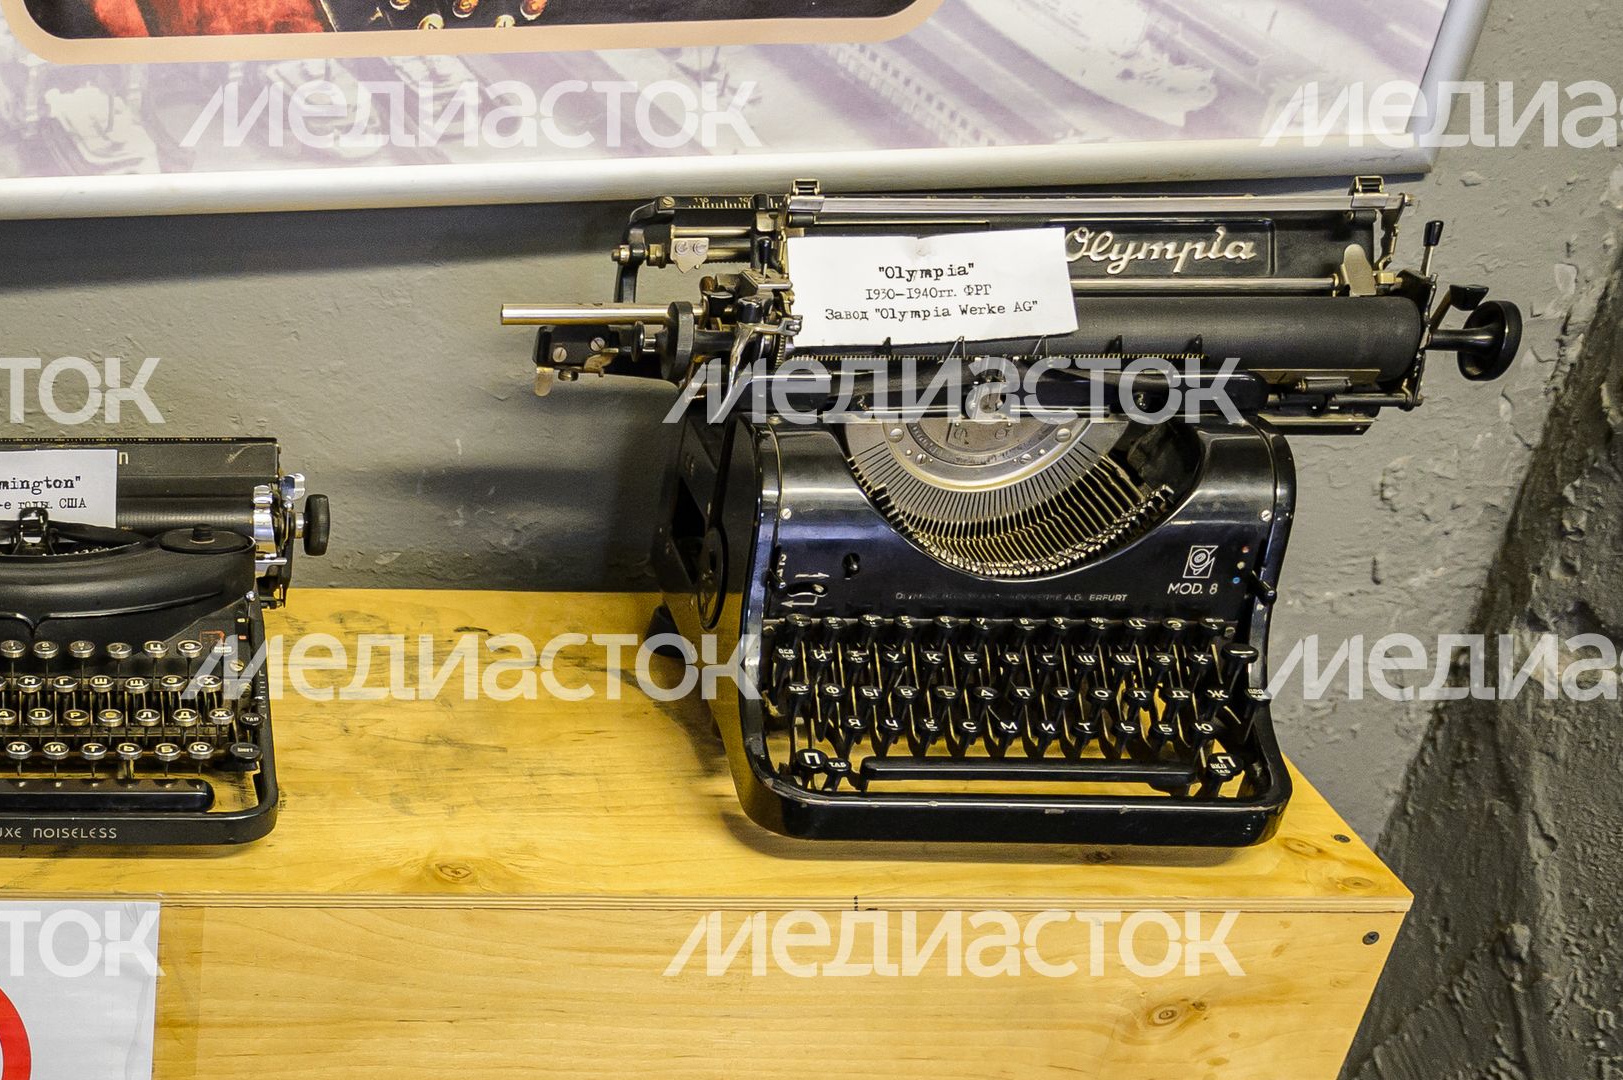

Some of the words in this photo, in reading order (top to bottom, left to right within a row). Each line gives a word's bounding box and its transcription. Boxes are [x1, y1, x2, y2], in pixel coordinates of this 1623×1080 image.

[1065, 226, 1258, 274] Olympia
[878, 261, 975, 283] "Olympia"
[963, 283, 993, 299] ФРГ
[825, 305, 869, 321] Завод
[874, 305, 952, 323] "Olympia
[959, 302, 1006, 317] Werke
[1012, 300, 1039, 314] AG"
[58, 497, 87, 509] США
[1166, 582, 1203, 595] MOD.
[1209, 582, 1219, 595] 8
[1088, 593, 1128, 602] ERFURT
[32, 827, 118, 839] NOISELESS
